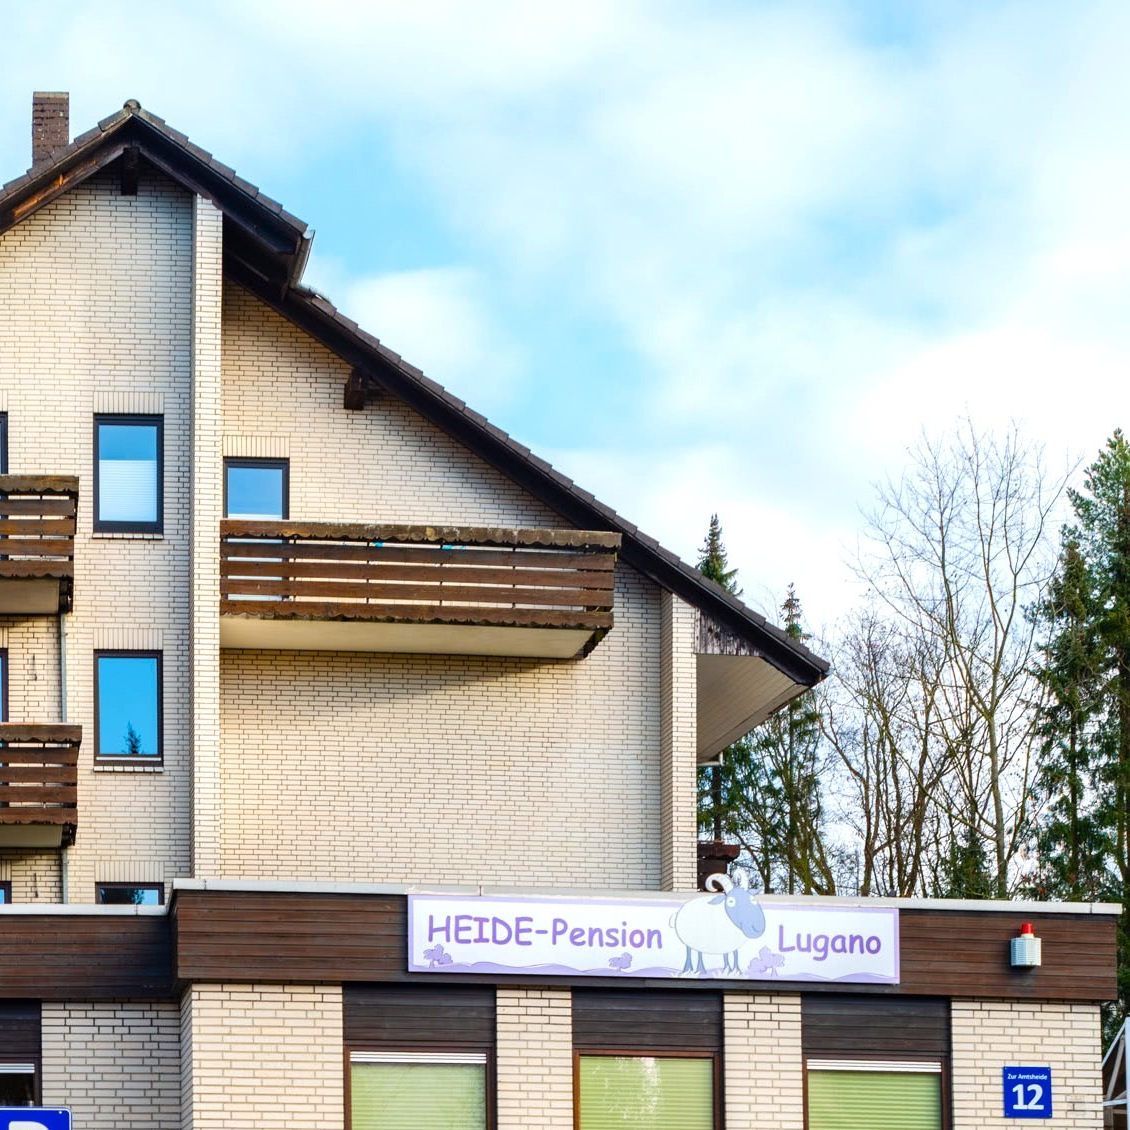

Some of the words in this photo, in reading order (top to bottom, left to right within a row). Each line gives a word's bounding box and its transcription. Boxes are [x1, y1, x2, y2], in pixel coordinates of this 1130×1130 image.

[427, 915, 662, 949] HEIDE-Pension
[778, 925, 882, 962] Lugano
[1012, 1084, 1044, 1110] 12
